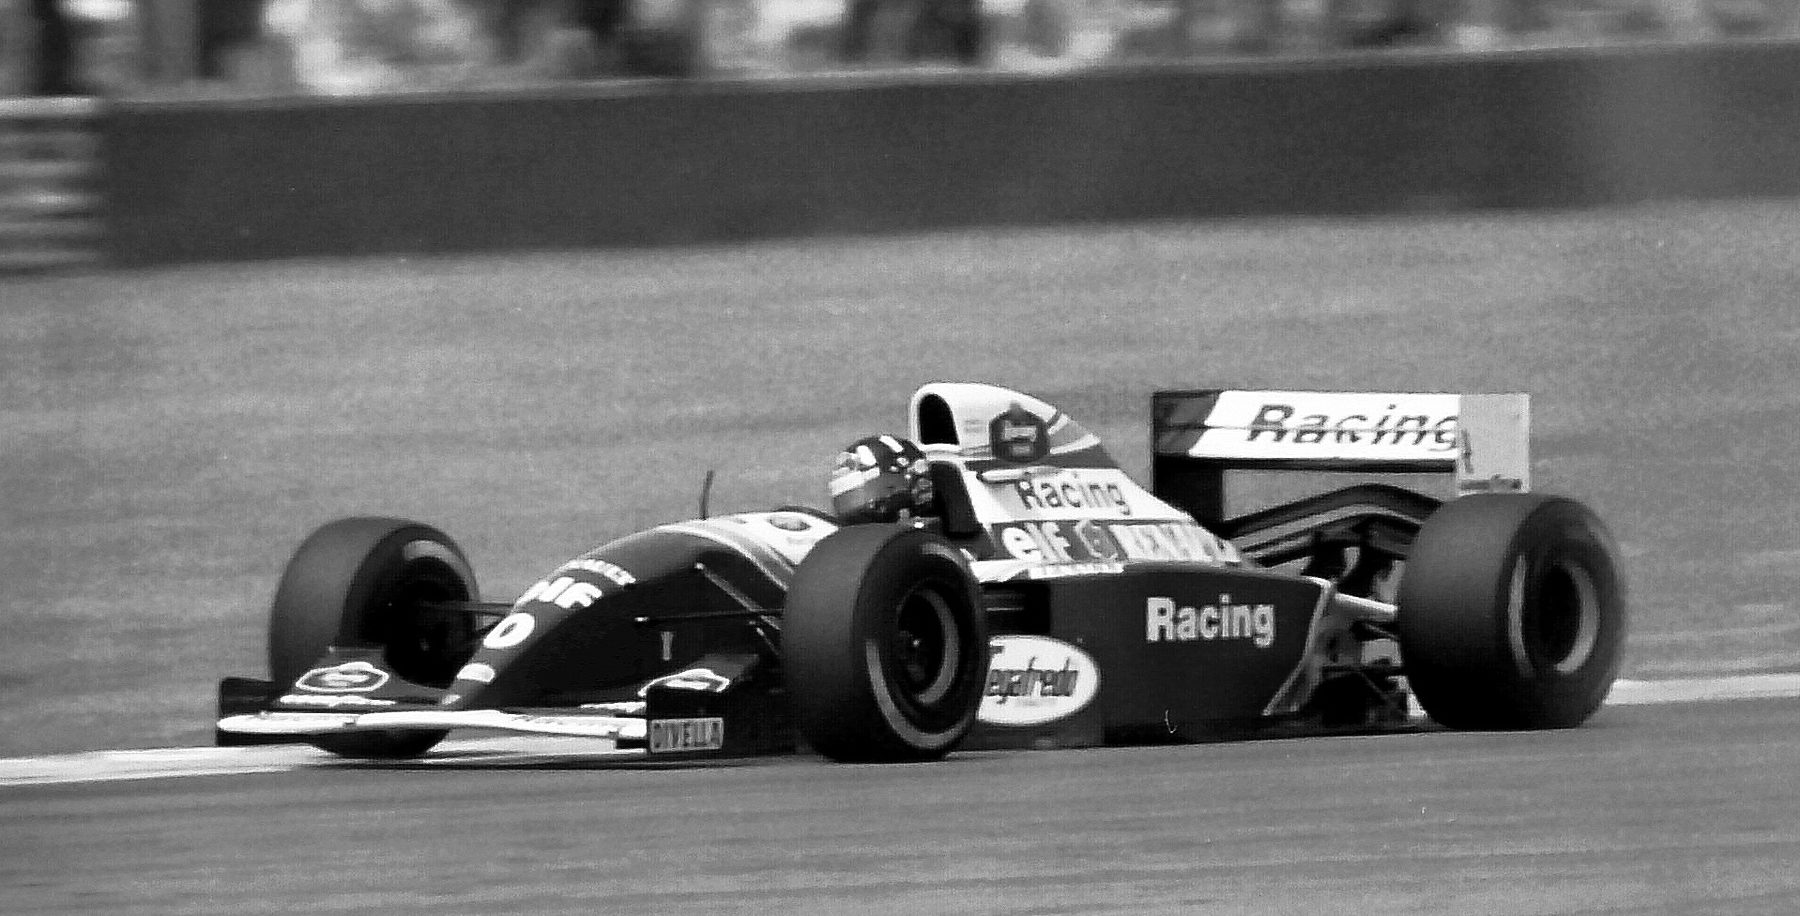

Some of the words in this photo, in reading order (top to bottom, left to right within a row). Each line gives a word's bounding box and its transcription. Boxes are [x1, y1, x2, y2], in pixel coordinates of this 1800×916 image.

[1247, 404, 1458, 452] Racing
[1016, 472, 1132, 516] Racing
[1001, 521, 1071, 562] elf
[1147, 593, 1275, 648] Racing
